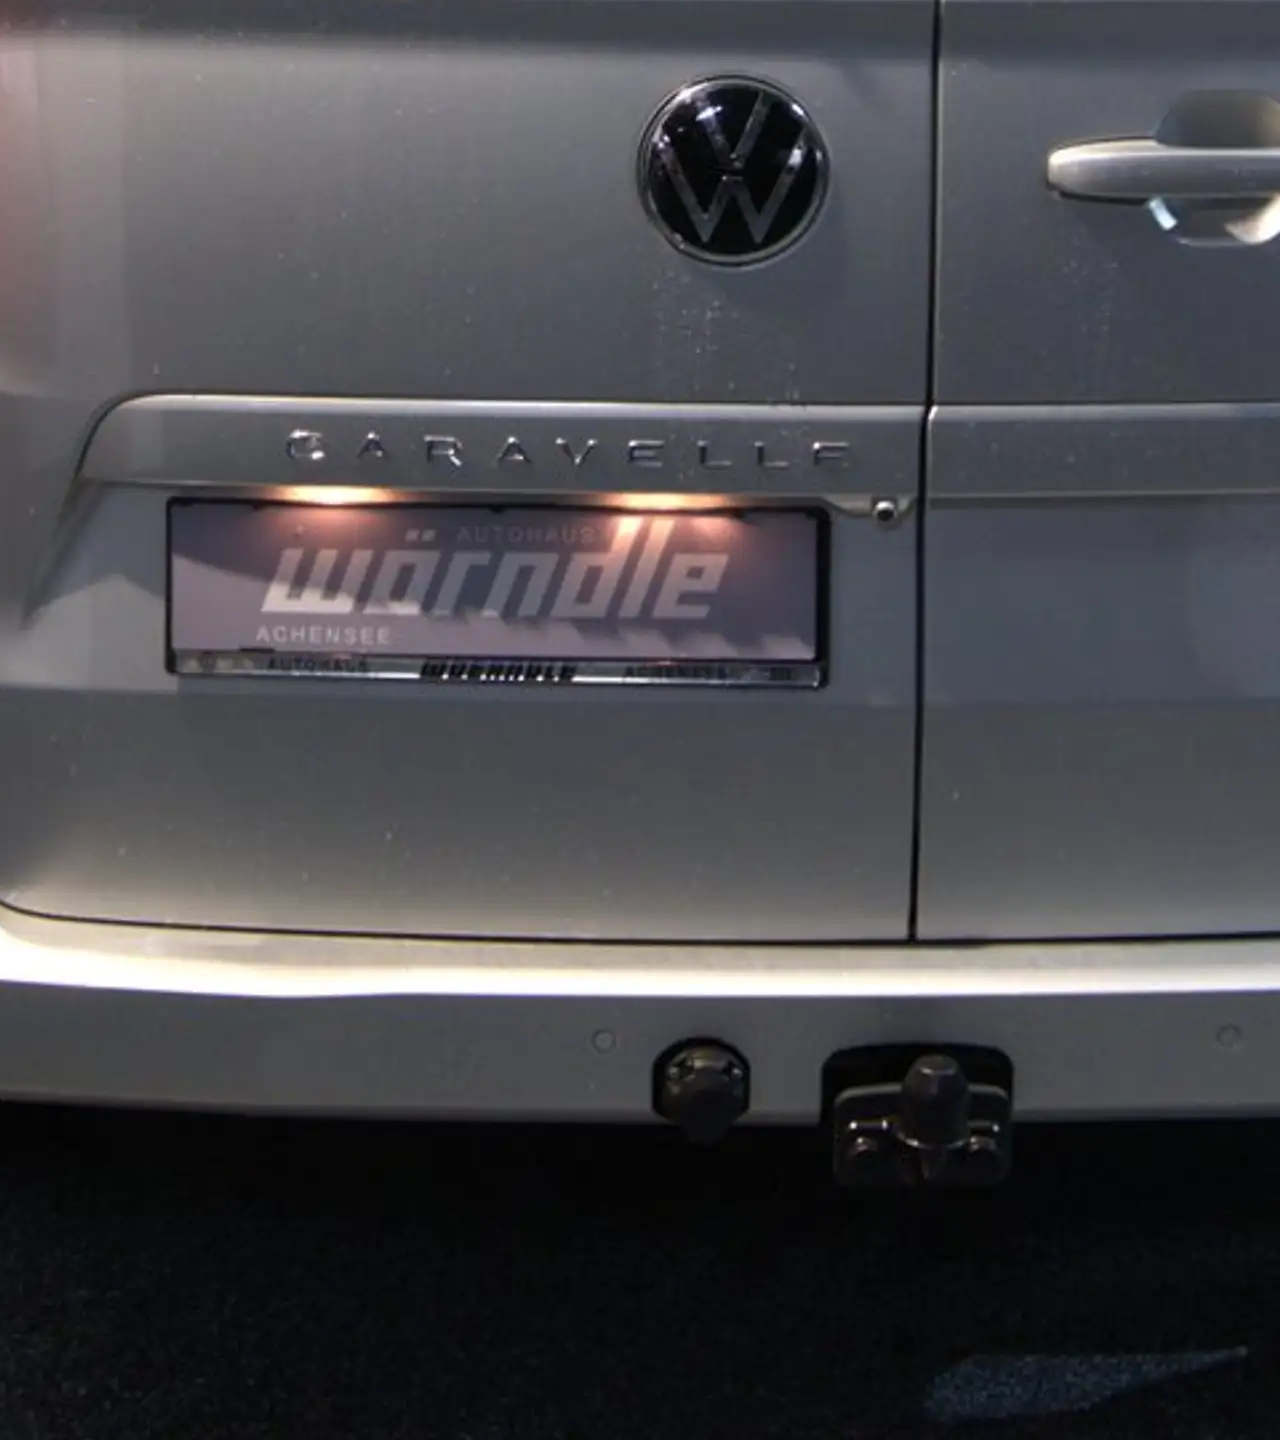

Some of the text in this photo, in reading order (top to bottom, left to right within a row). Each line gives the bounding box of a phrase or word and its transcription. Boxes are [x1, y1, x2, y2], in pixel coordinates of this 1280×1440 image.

[284, 428, 852, 469] CARAVELLE
[455, 525, 601, 545] AUTOHAUS
[254, 625, 392, 646] ACHENSEE
